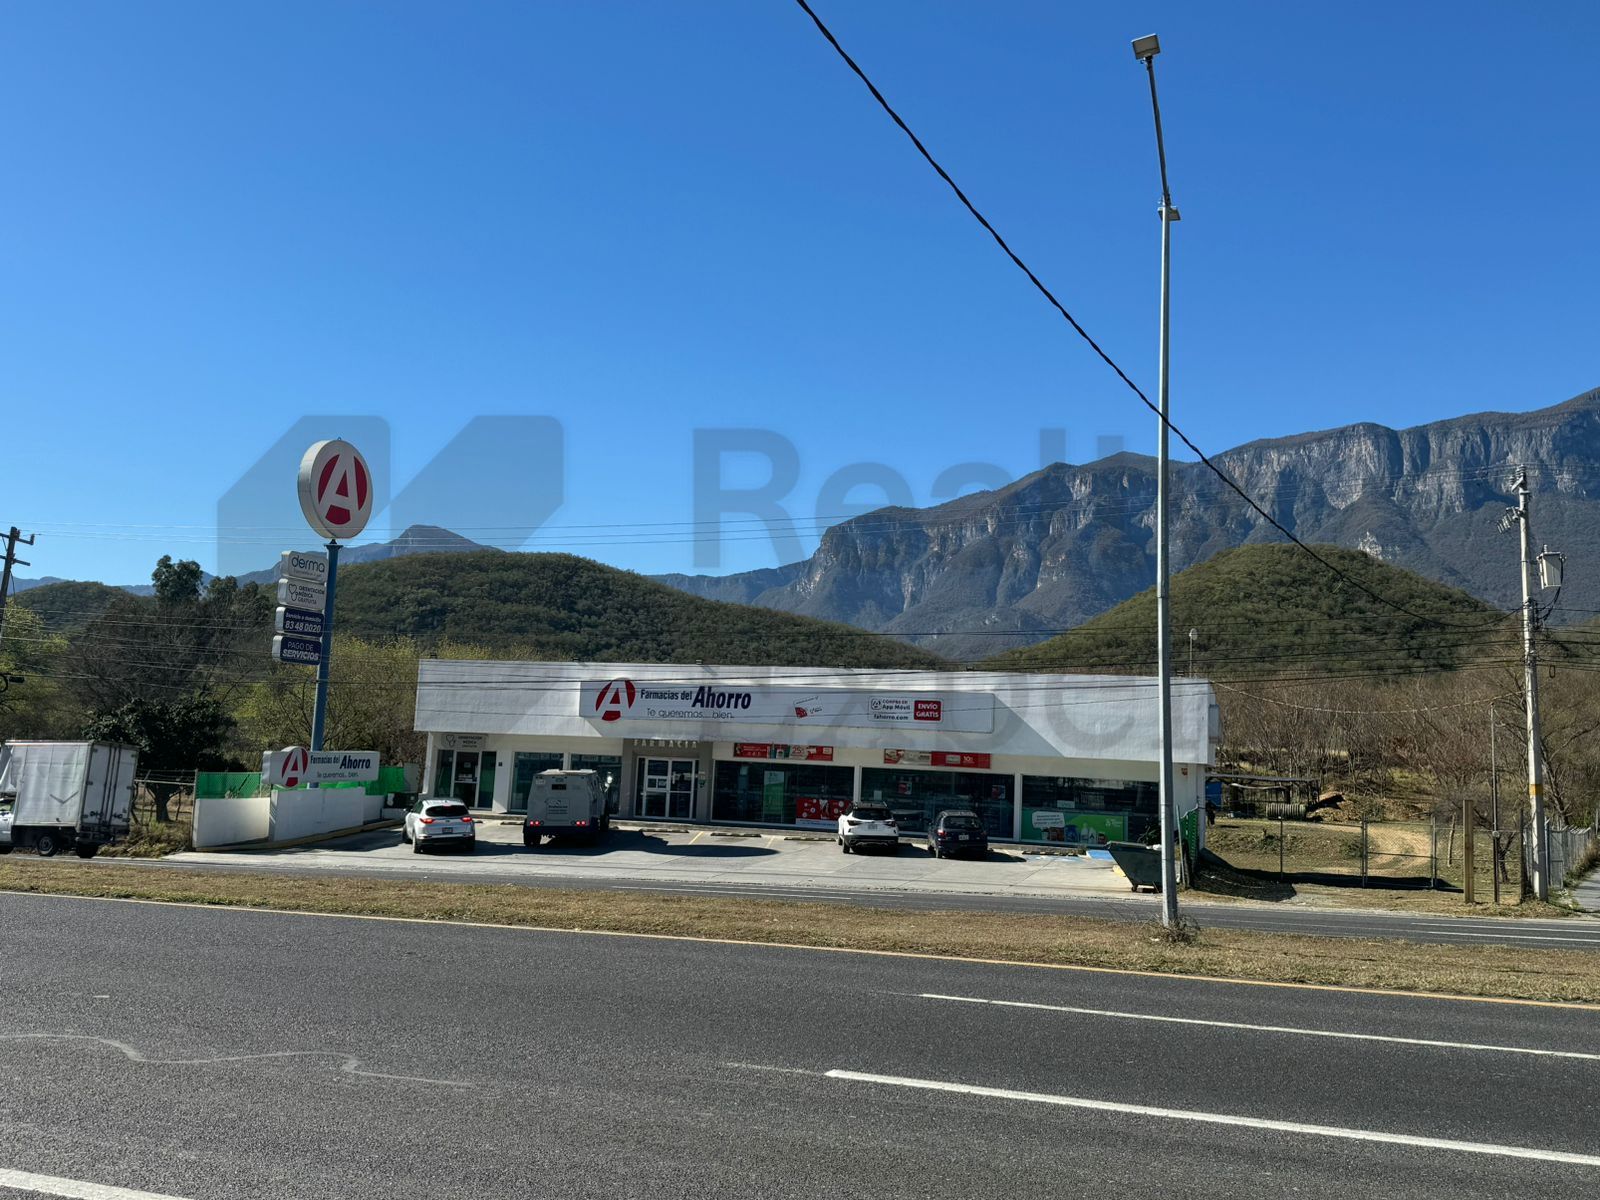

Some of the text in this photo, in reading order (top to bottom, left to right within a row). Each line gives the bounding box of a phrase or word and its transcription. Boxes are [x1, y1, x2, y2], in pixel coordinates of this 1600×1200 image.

[291, 555, 325, 573] derma
[285, 620, 295, 630] 83
[287, 641, 314, 651] PAGO DE
[282, 648, 319, 661] SERVICIOS
[640, 686, 752, 710] Farmacias del Ahorro
[647, 708, 656, 717] Te
[916, 711, 939, 719] GRATIS
[633, 739, 697, 749] FARMACIA
[310, 754, 371, 770] Farmacias del Ahorro
